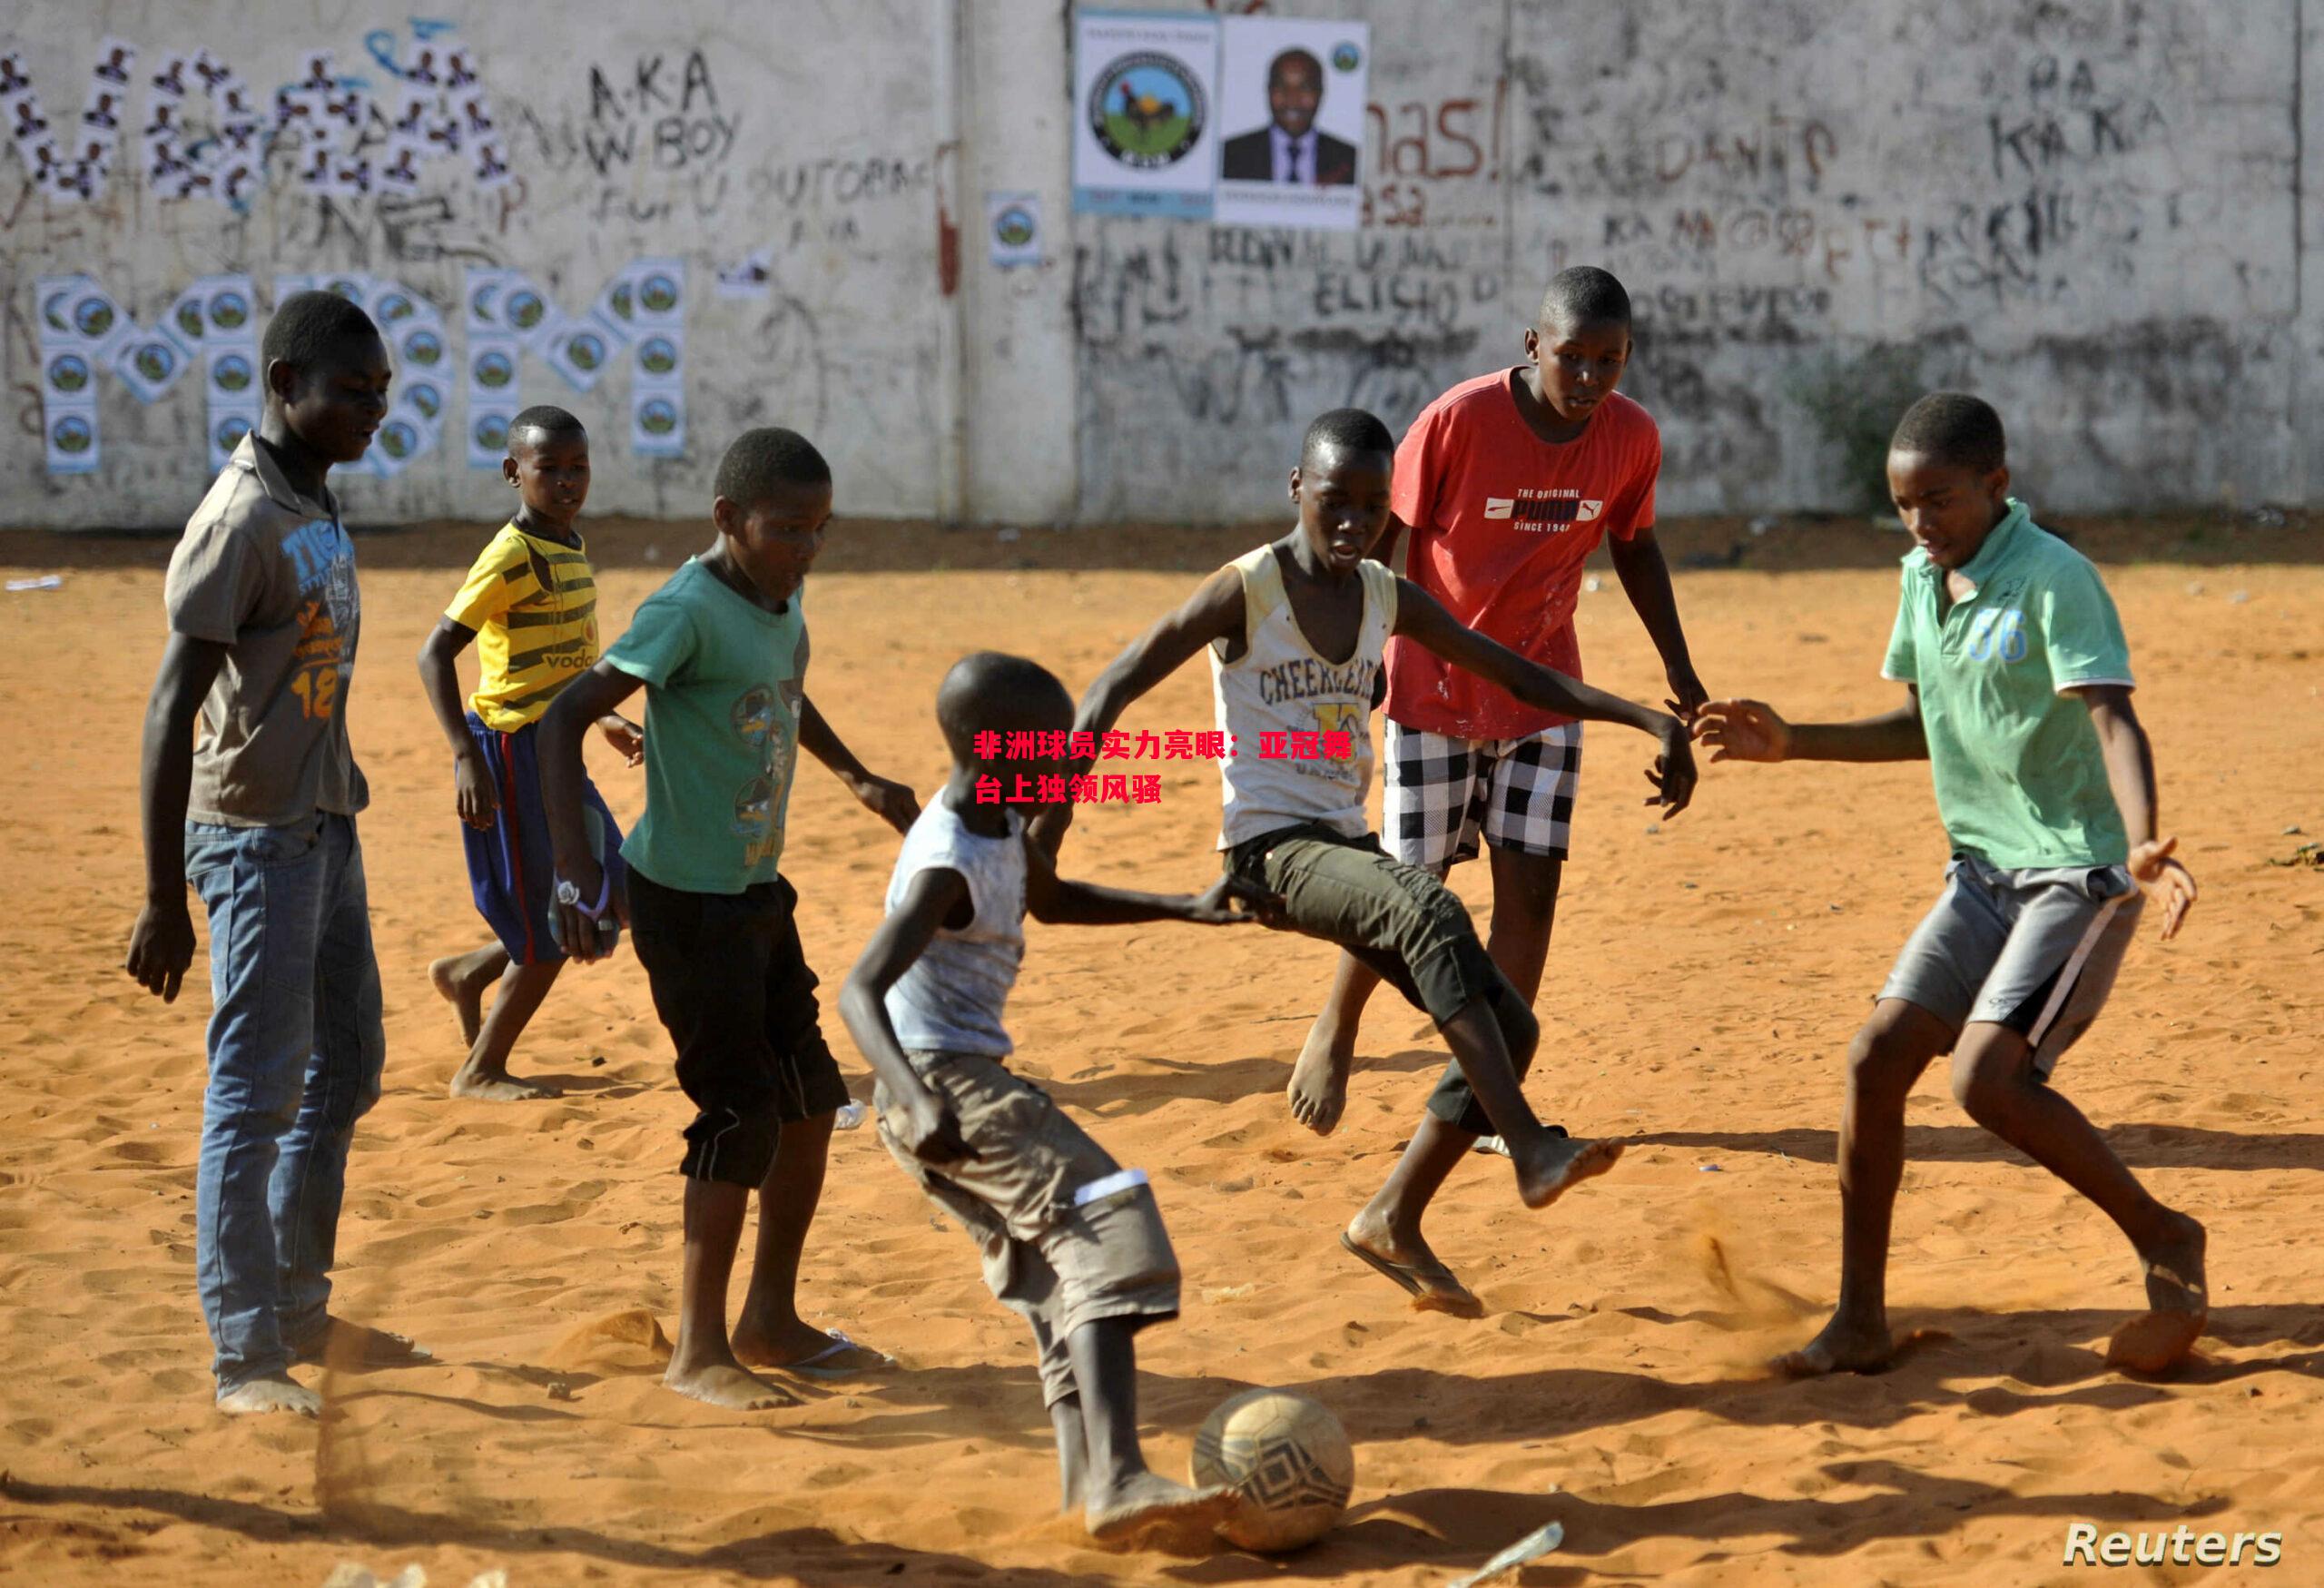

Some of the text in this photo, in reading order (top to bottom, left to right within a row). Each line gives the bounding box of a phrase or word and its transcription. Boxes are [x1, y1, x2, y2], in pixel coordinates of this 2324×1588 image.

[1517, 488, 1580, 499] THE ORIGINAL
[1513, 520, 1542, 532] SINCE
